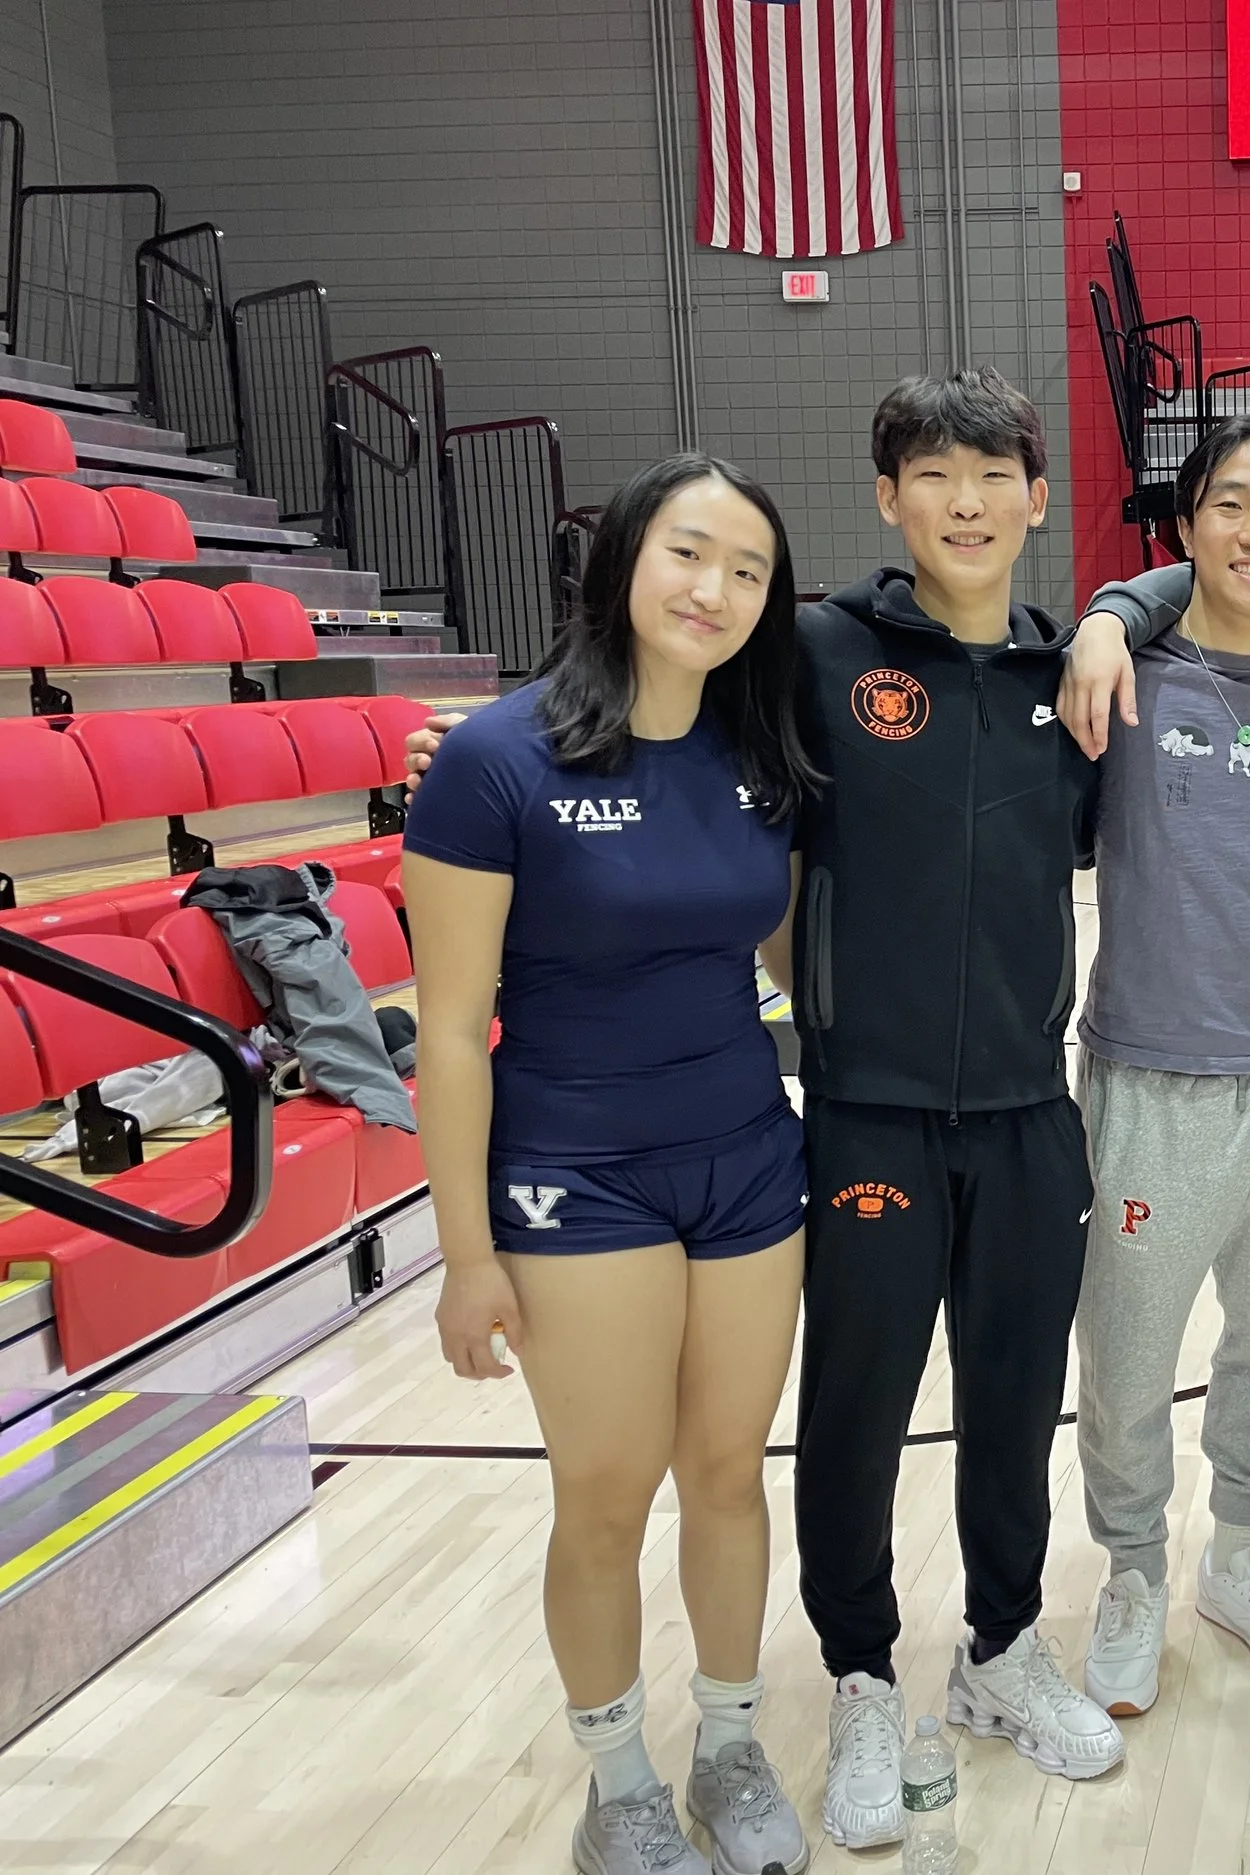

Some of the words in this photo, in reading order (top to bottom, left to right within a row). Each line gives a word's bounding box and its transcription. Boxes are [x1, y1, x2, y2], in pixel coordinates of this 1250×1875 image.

[791, 274, 816, 296] EXIT
[859, 672, 920, 694] PRINCETON
[868, 721, 914, 737] FENCING
[549, 799, 642, 822] YALE
[577, 822, 623, 832] FENCING
[508, 1185, 568, 1229] Y
[831, 1182, 911, 1210] PRINCETON
[1119, 1197, 1152, 1236] P
[922, 1778, 950, 1800] Poland
[924, 1787, 952, 1808] Spring
